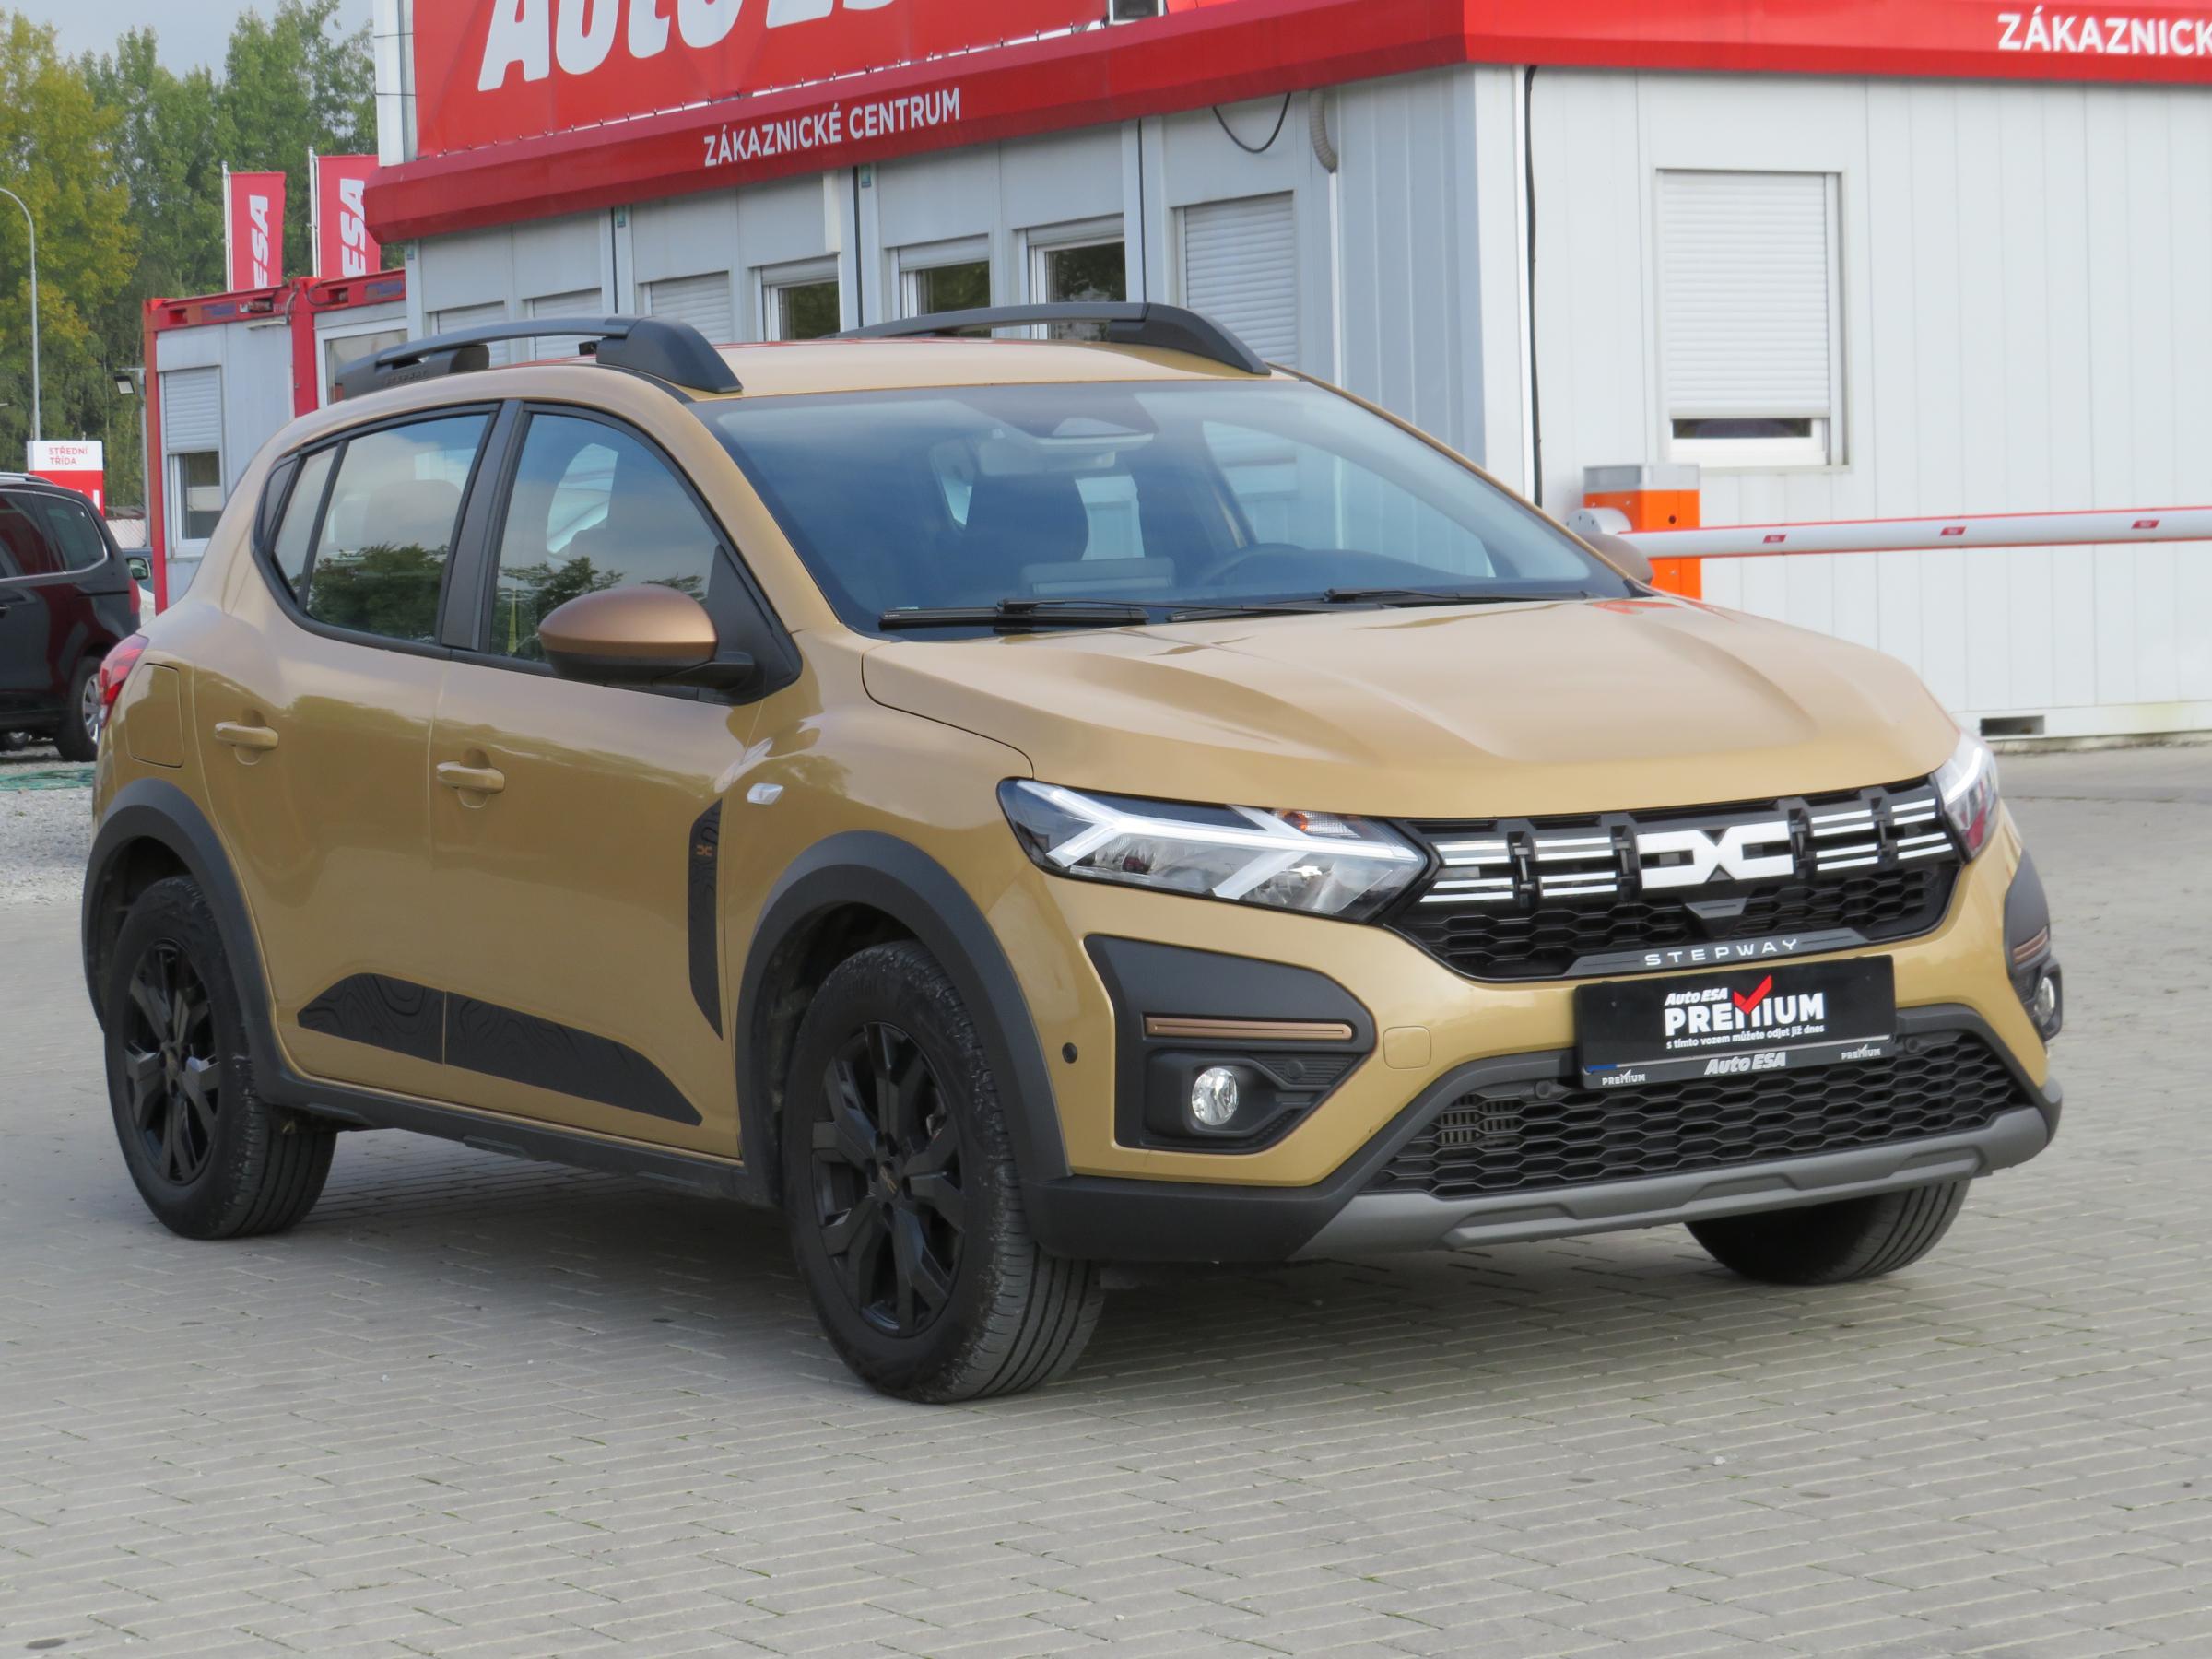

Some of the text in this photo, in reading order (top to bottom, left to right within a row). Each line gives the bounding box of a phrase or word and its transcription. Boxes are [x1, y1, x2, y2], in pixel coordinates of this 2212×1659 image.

[704, 88, 960, 167] ZÁKAZNICKÉ CENTRUM
[249, 194, 269, 288] ESA
[340, 179, 367, 276] ESA
[1644, 938, 1797, 966] STEPWAY
[1665, 987, 1728, 1006] Auto ESA
[1665, 992, 1825, 1037] PREMIUM
[1666, 1041, 1673, 1049] s
[1674, 1038, 1700, 1049] tímto
[1700, 1035, 1731, 1046] vozem
[1732, 1030, 1765, 1042] můžete
[1767, 1027, 1790, 1039] odjet
[1804, 1024, 1825, 1034] dnes
[1704, 1051, 1786, 1076] Auto ESA
[1602, 1072, 1646, 1086] PREMIUM
